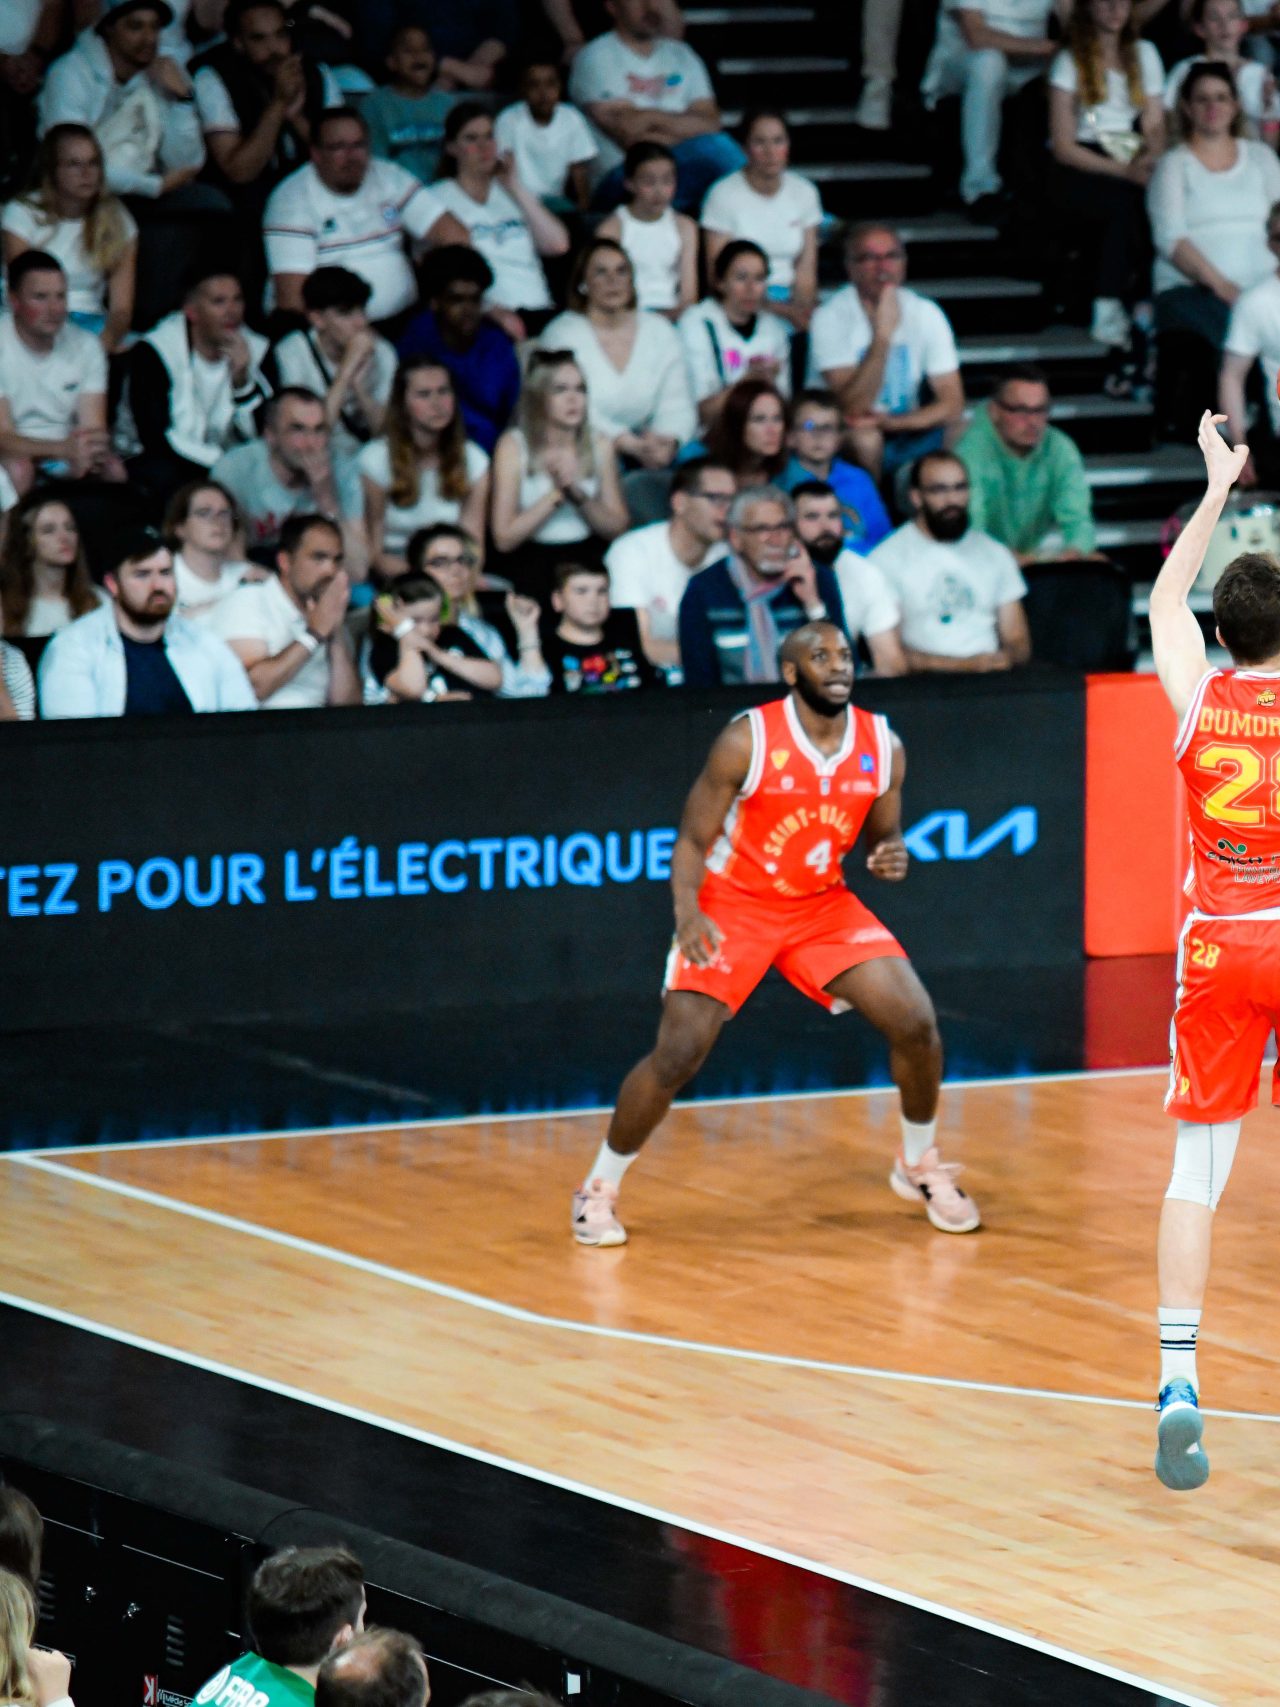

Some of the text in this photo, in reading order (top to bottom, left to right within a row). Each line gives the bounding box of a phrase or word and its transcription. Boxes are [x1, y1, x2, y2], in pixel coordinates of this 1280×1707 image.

[0, 827, 681, 917] EZ POUR L'ÉLECTRIQUE
[805, 839, 832, 876] 4
[1192, 937, 1220, 969] 28
